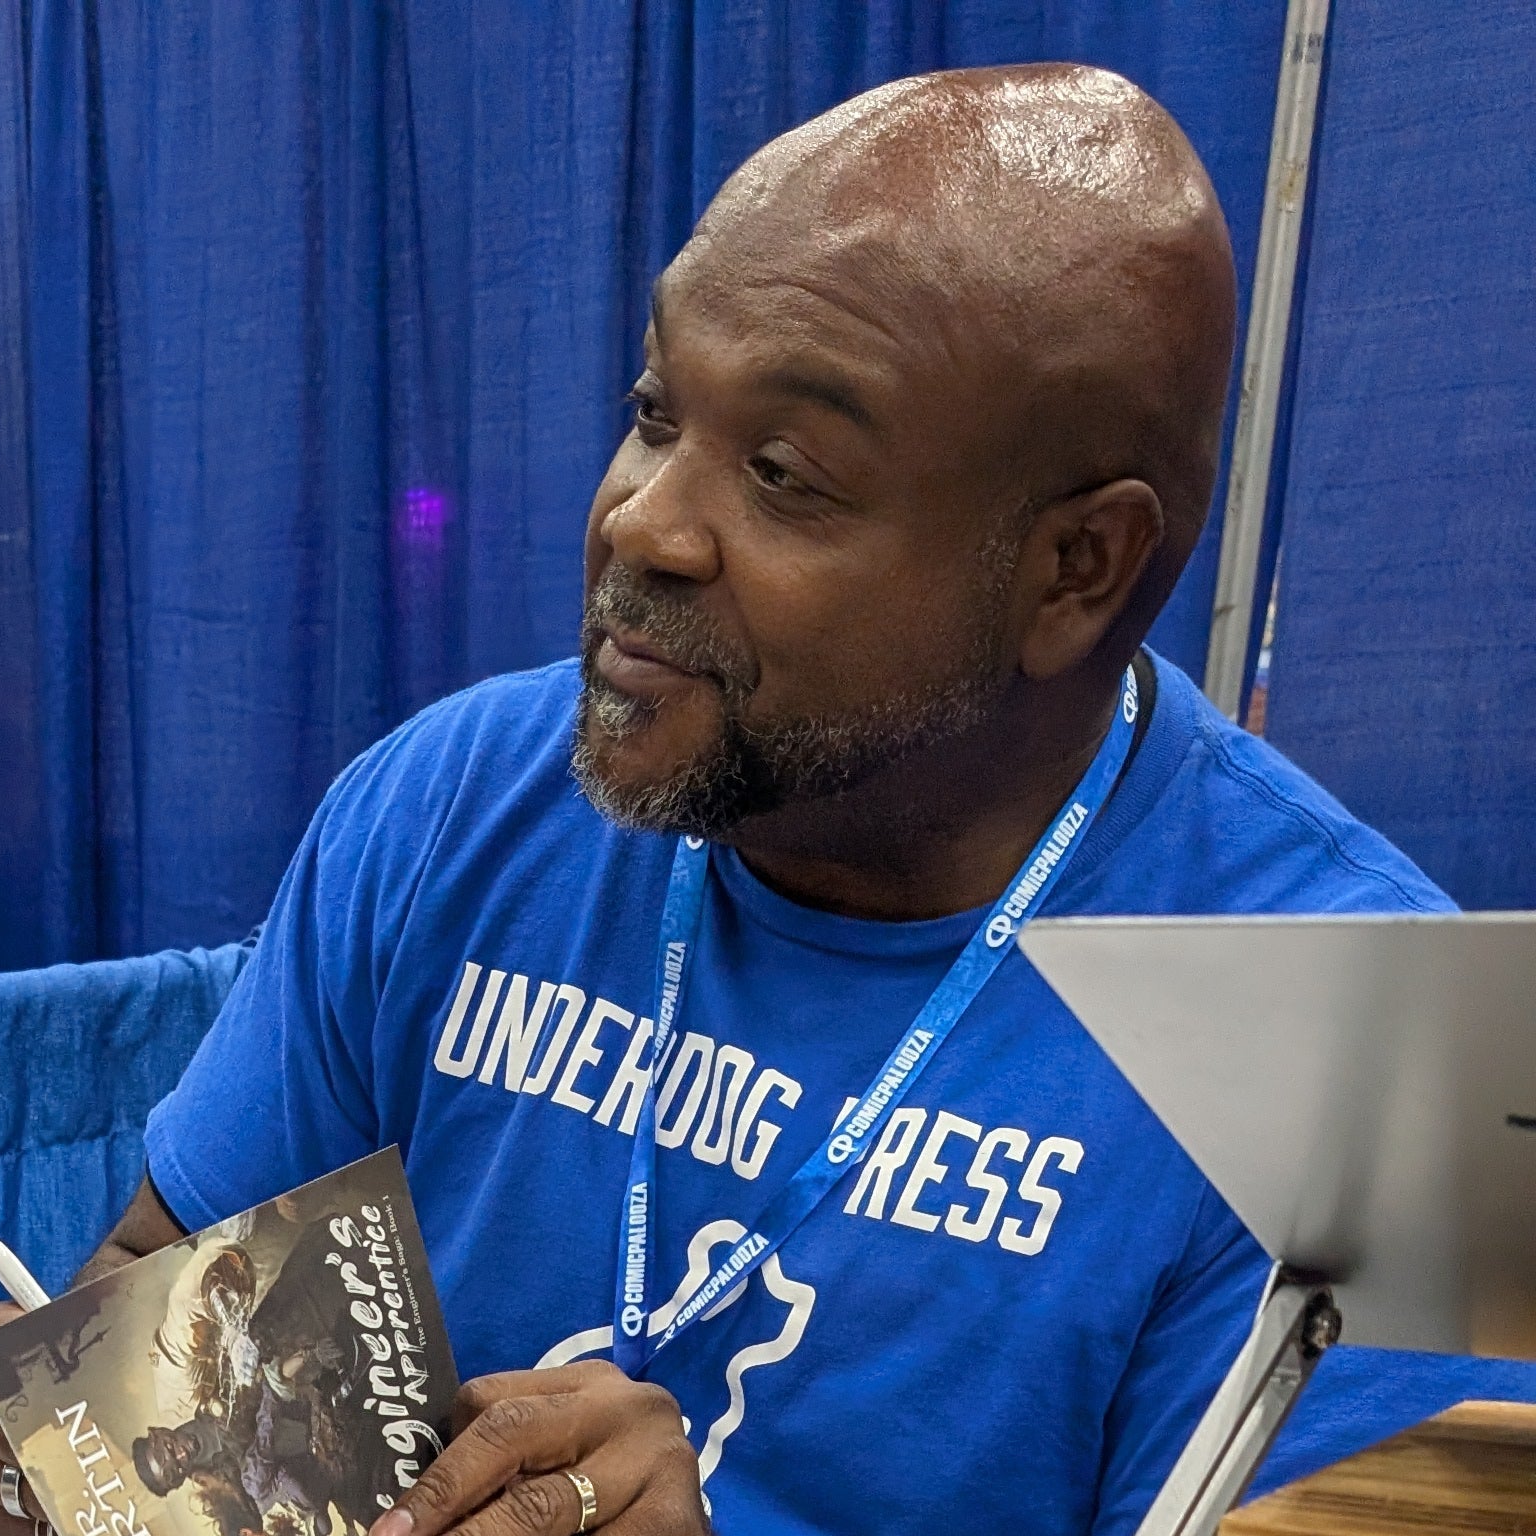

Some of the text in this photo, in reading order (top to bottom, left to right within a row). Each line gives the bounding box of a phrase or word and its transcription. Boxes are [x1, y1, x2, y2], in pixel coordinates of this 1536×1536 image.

[1003, 802, 1089, 921] COMICPALOOZA
[434, 961, 1084, 1257] UNDERDOG RESS
[845, 1029, 934, 1140] COMICPALOOZA
[385, 1204, 398, 1233] Book
[623, 1181, 648, 1304] COMICPALOOZA
[402, 1267, 422, 1326] Engineer's
[676, 1232, 770, 1327] COMICPALOOZA
[324, 1215, 445, 1489] ngineer's
[417, 1326, 427, 1347] The
